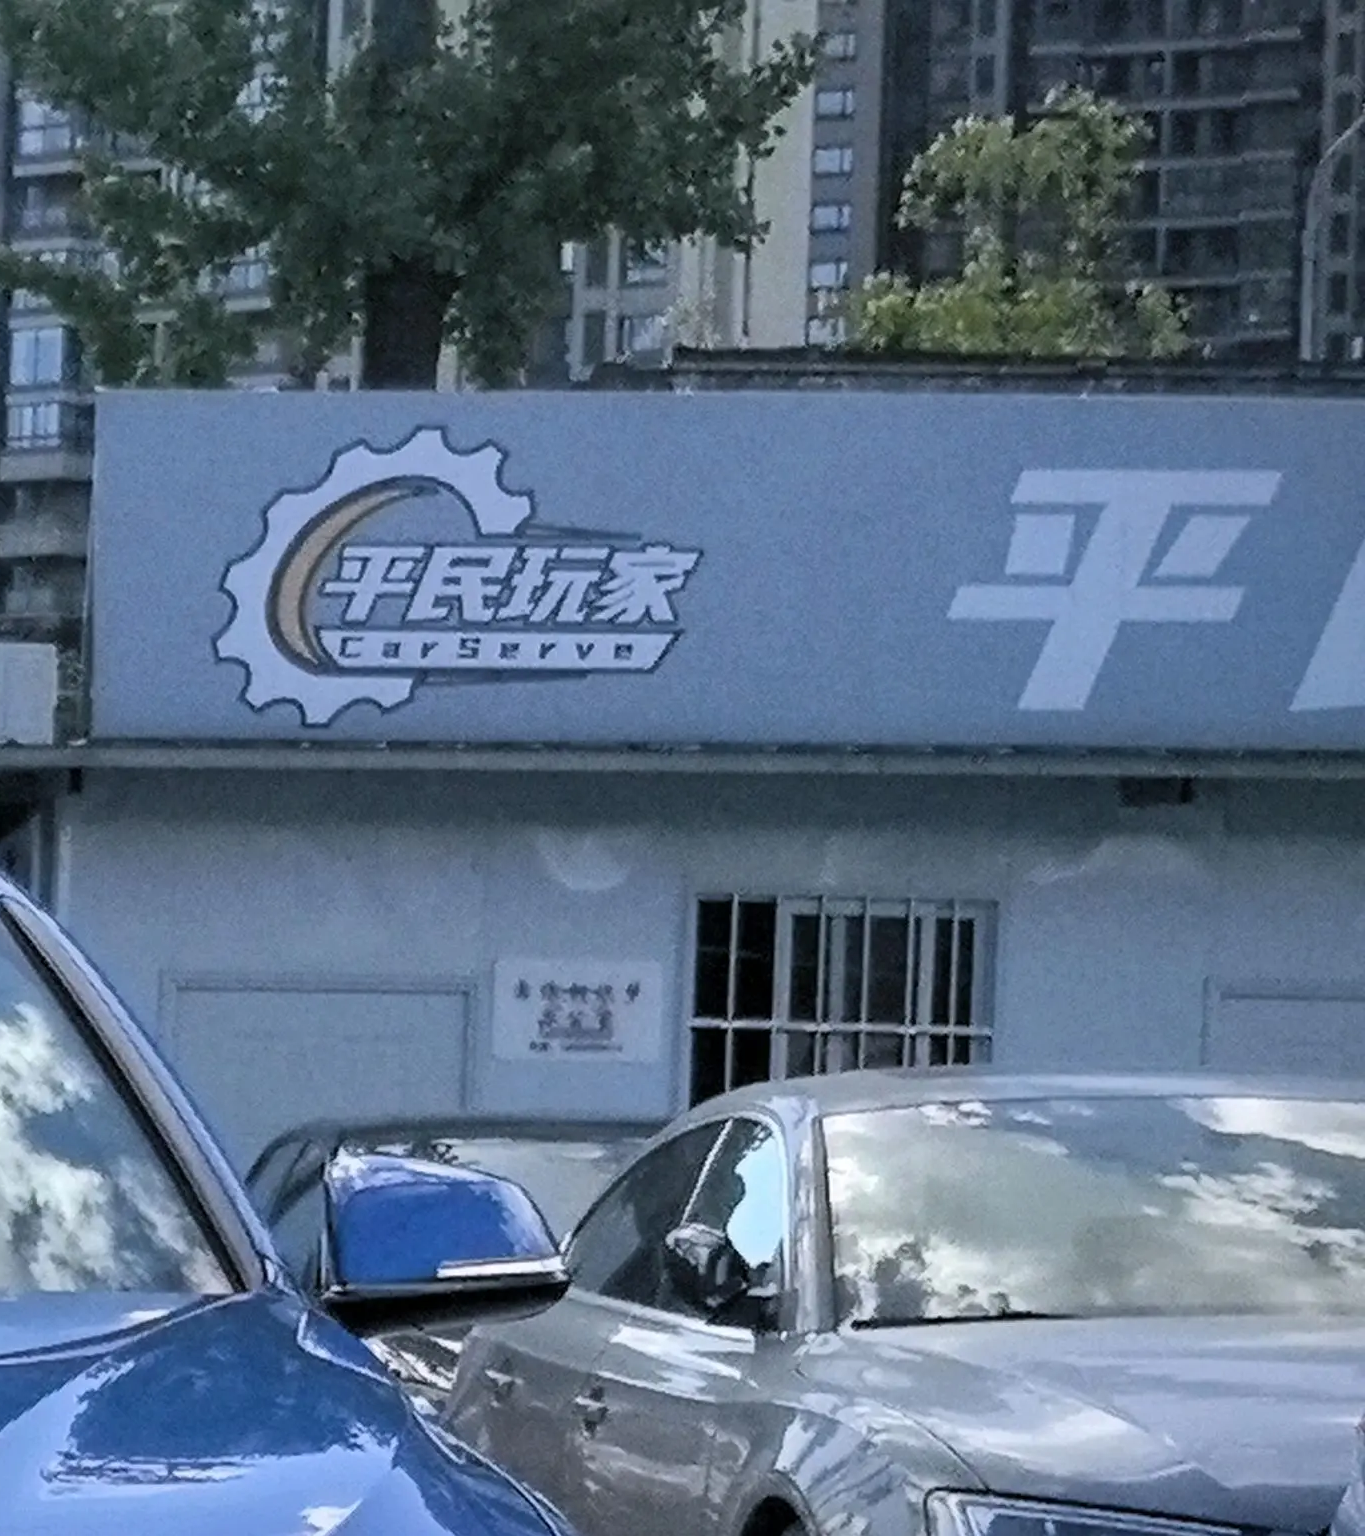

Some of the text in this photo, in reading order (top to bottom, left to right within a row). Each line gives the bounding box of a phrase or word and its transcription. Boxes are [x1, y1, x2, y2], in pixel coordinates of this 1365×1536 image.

[319, 542, 703, 625] 平民玩家
[338, 636, 636, 661] CarServe
